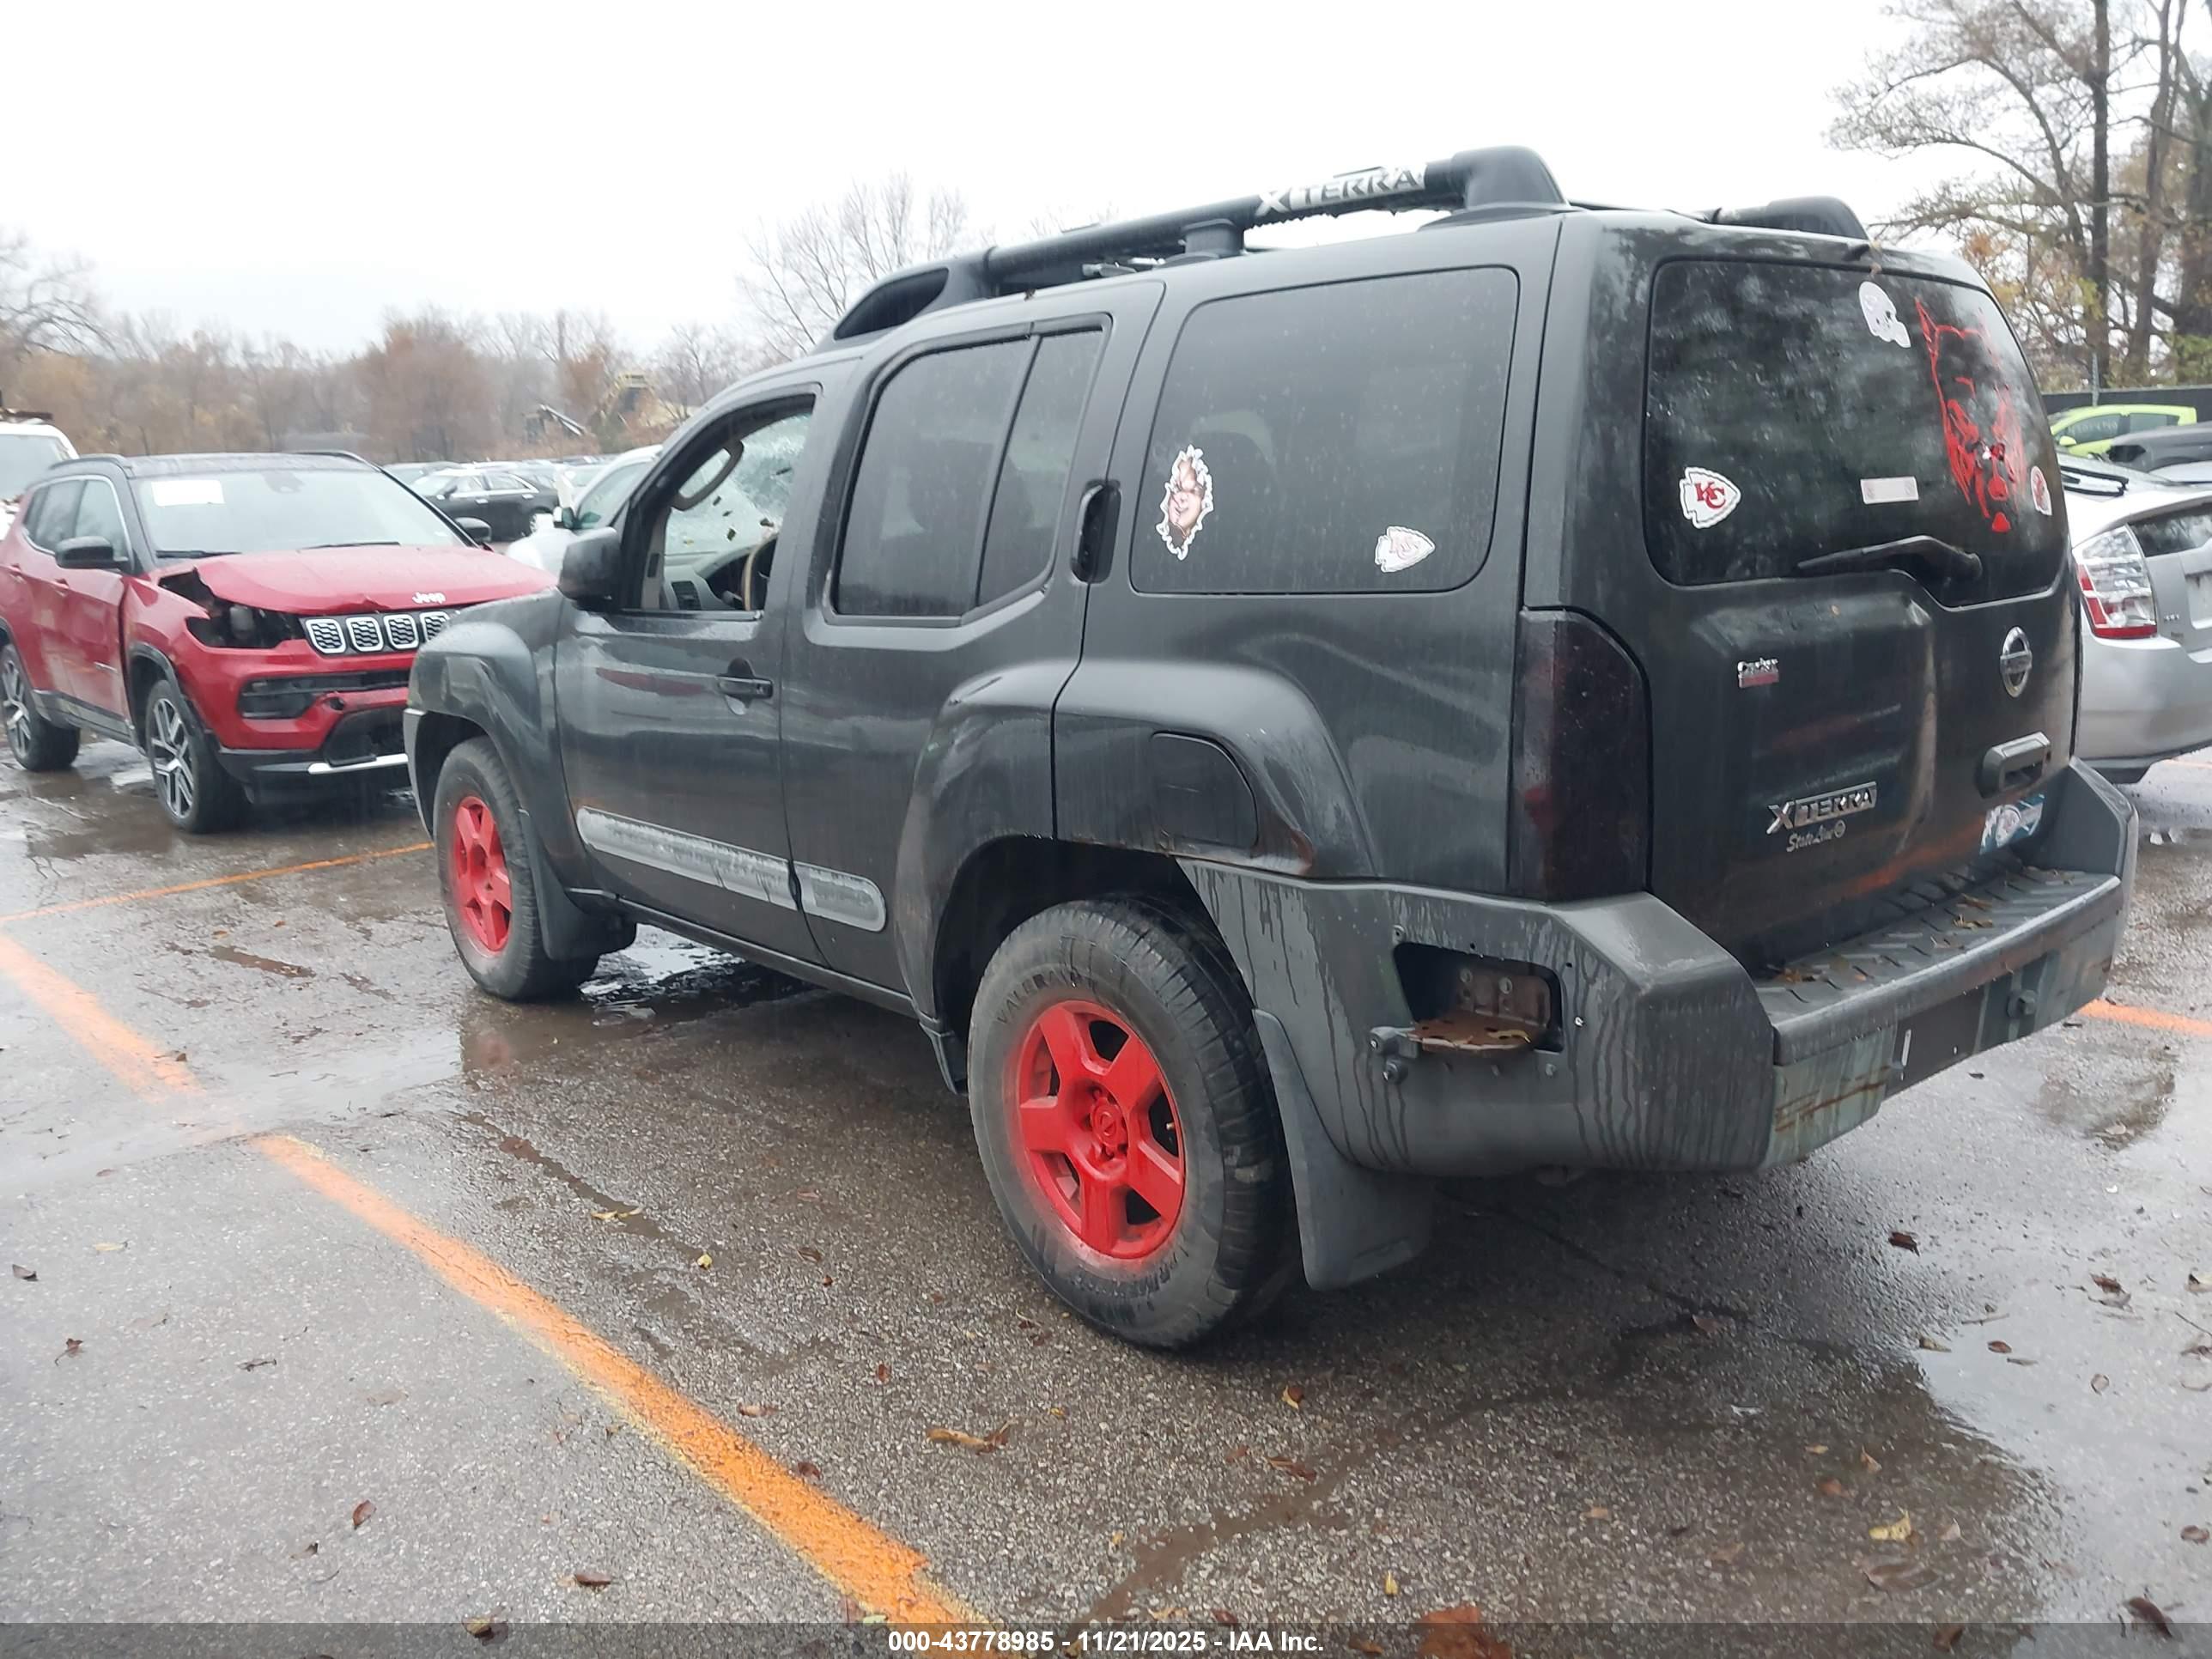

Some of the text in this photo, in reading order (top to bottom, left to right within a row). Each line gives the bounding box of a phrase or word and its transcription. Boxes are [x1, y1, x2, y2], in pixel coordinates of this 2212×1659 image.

[1255, 167, 1422, 216] XTERRA
[411, 592, 447, 605] Jeep
[1766, 781, 1877, 835] XTERRA
